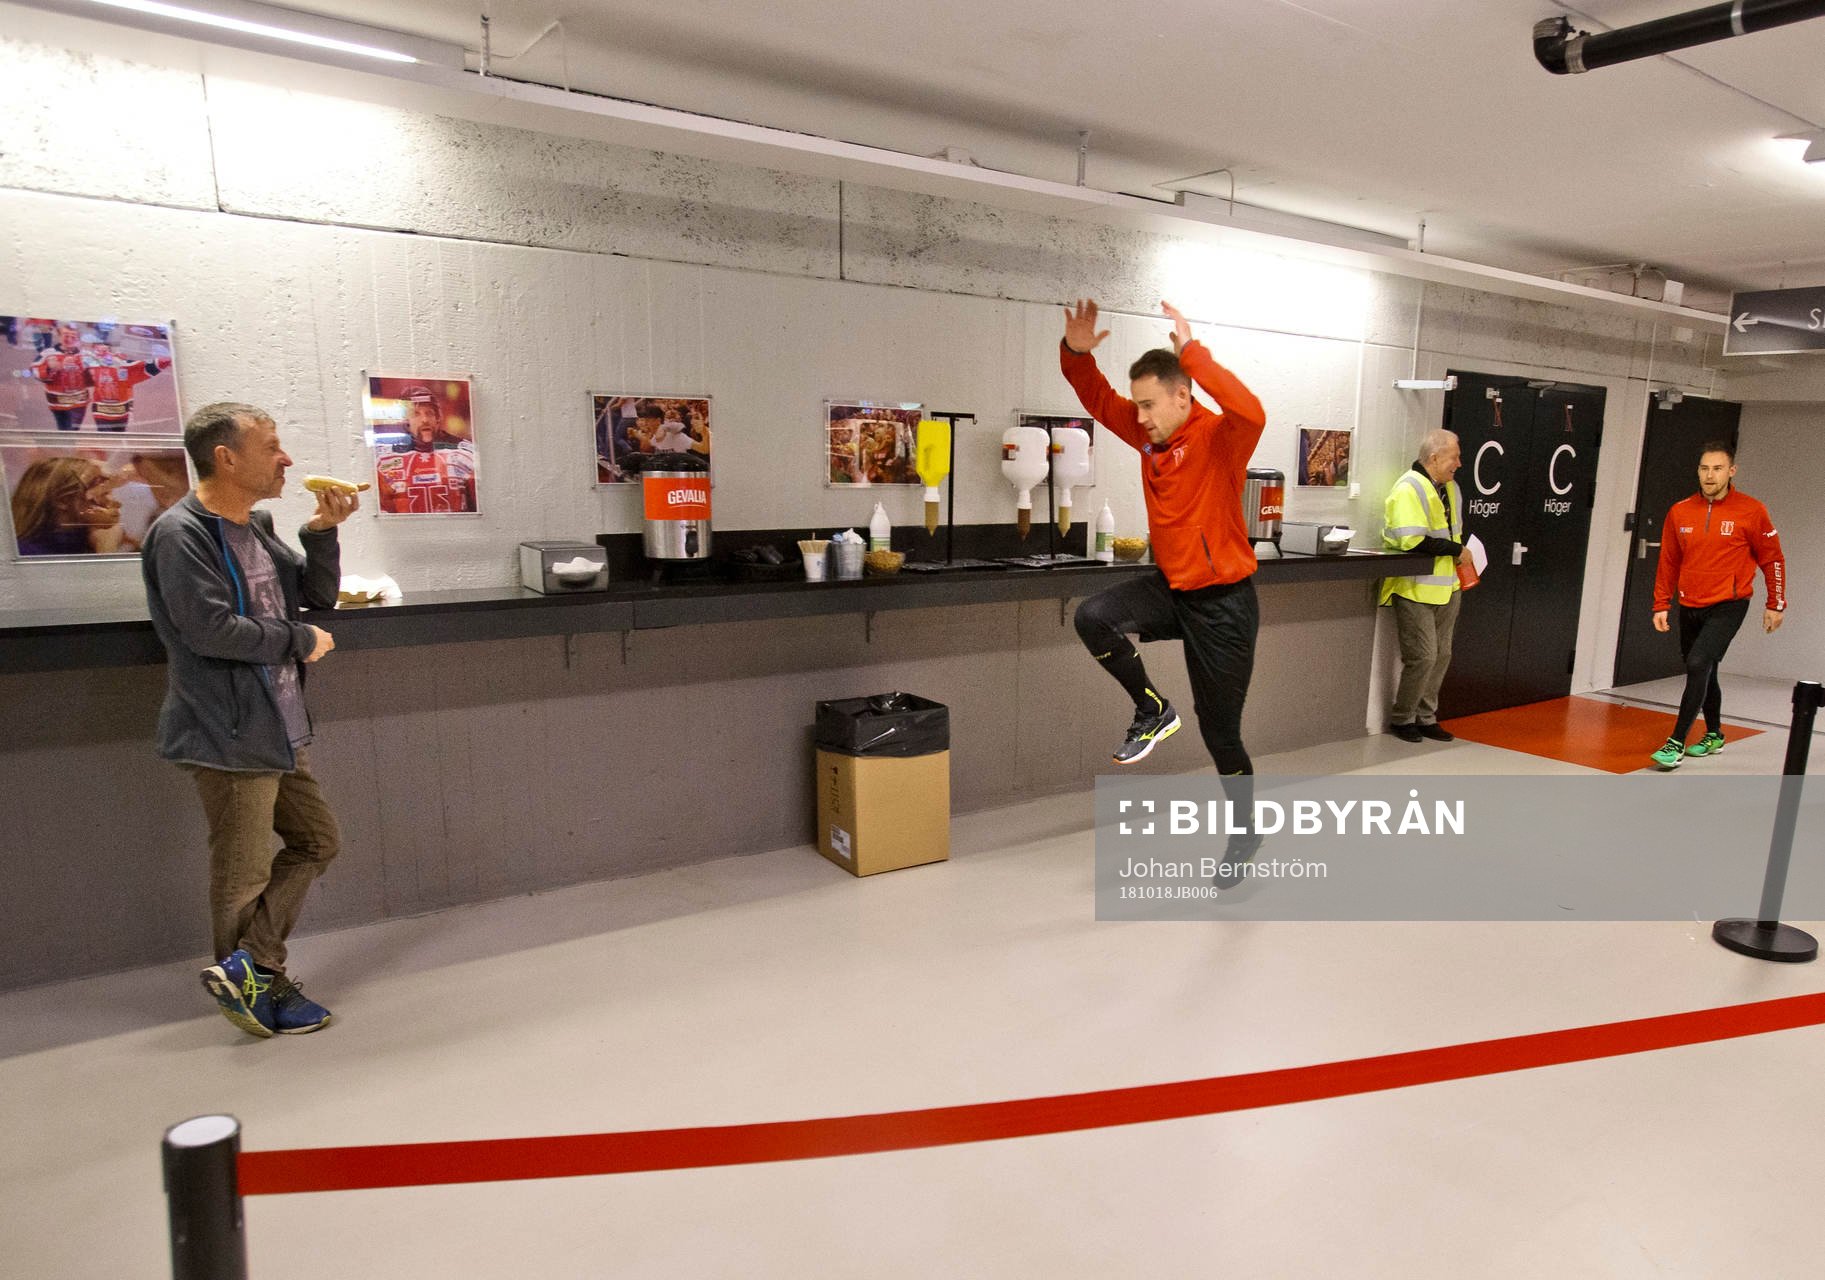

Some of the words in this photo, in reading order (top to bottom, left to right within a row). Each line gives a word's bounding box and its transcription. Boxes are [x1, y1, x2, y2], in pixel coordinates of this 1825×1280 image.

[1807, 308, 1825, 329] S
[1474, 440, 1504, 495] C
[1549, 444, 1577, 495] C
[667, 489, 707, 504] GEVALIA
